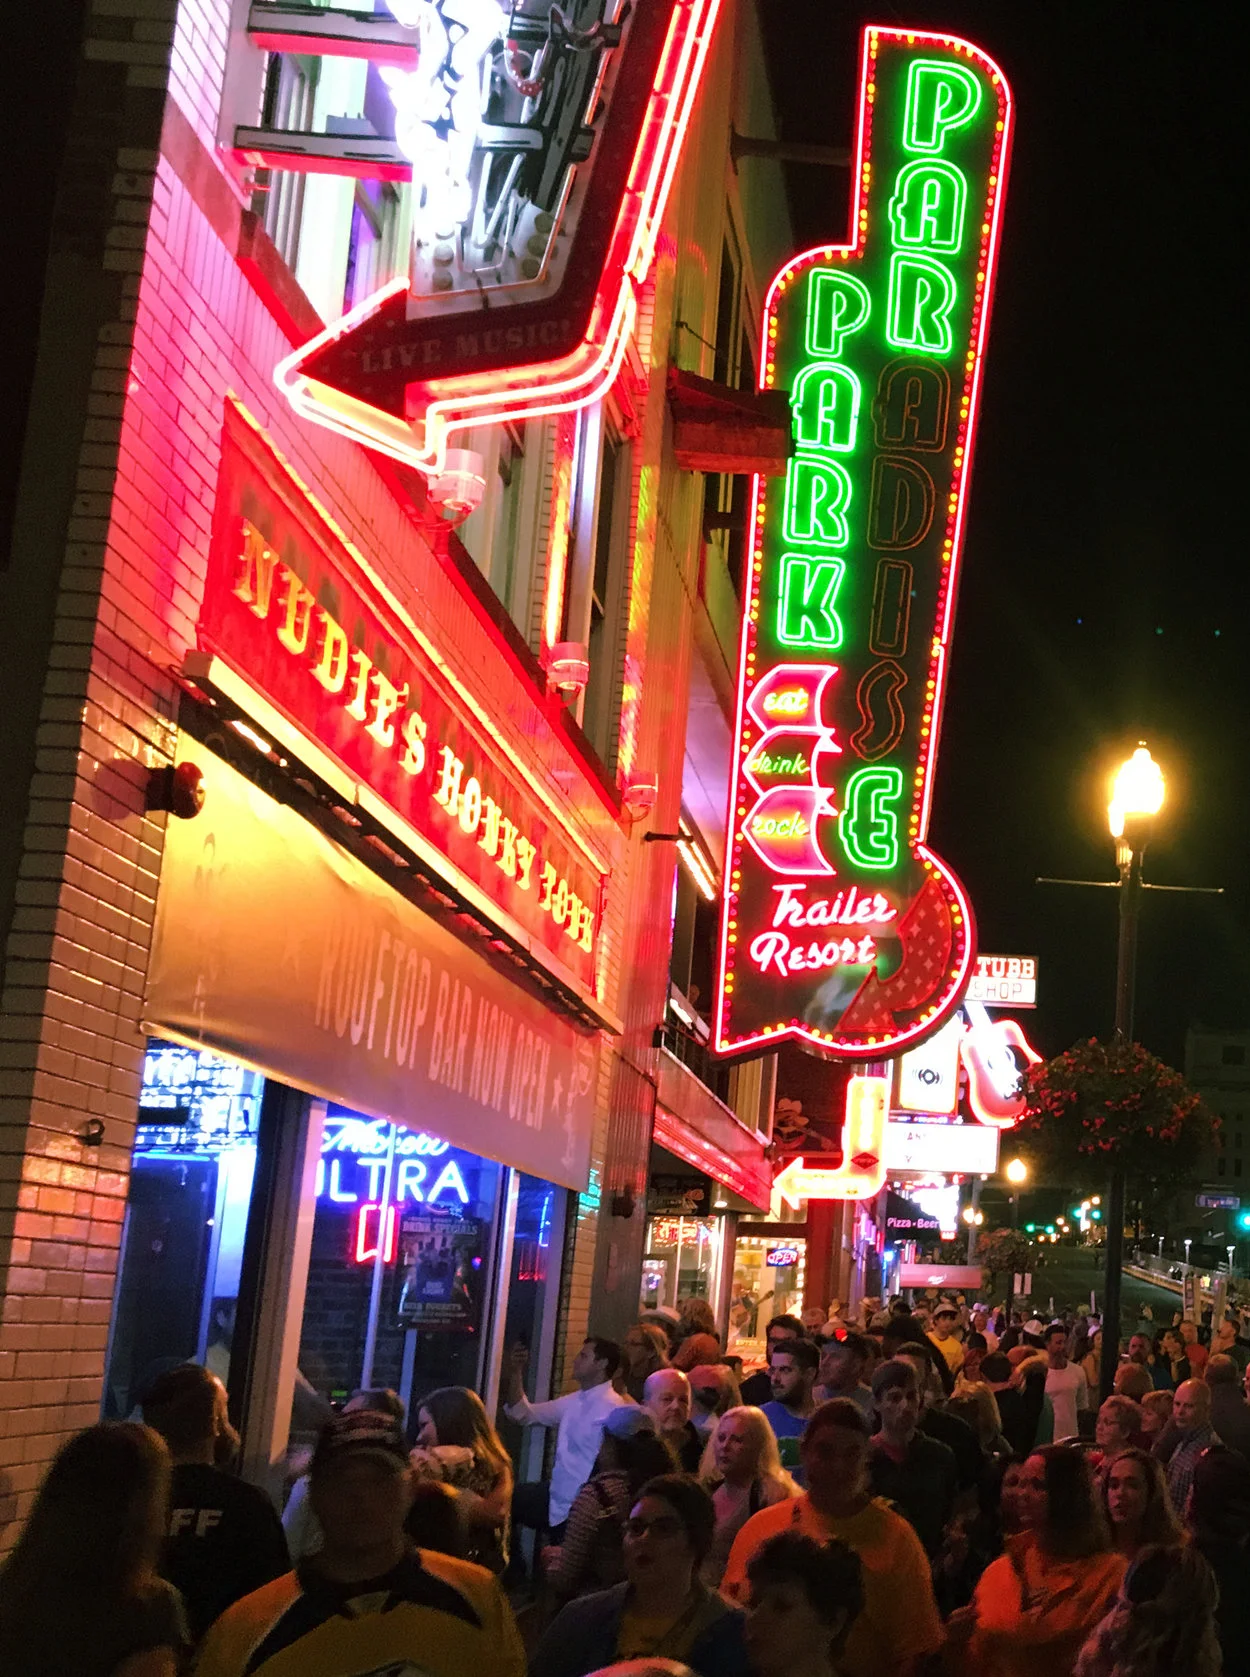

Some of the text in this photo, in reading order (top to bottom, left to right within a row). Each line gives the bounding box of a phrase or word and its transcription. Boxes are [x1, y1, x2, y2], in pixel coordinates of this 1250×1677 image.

[361, 338, 442, 373] LIVE
[777, 267, 872, 649] PARK
[839, 59, 982, 869] PARADISE
[233, 516, 428, 776] NUDIE'S
[432, 745, 538, 890] HONKY
[762, 688, 809, 711] eat
[749, 751, 811, 774] drink
[751, 812, 810, 836] rock
[771, 884, 897, 928] Trailer
[749, 931, 877, 977] Resort
[976, 956, 1036, 979] TUBB
[973, 981, 1023, 999] SHOP
[428, 969, 472, 1094] BAR
[467, 995, 513, 1112] NOW
[508, 1022, 552, 1131] OPEN
[886, 1217, 940, 1229] Pizza Beer
[767, 1248, 798, 1265] OPEN
[166, 1507, 223, 1537] FF
